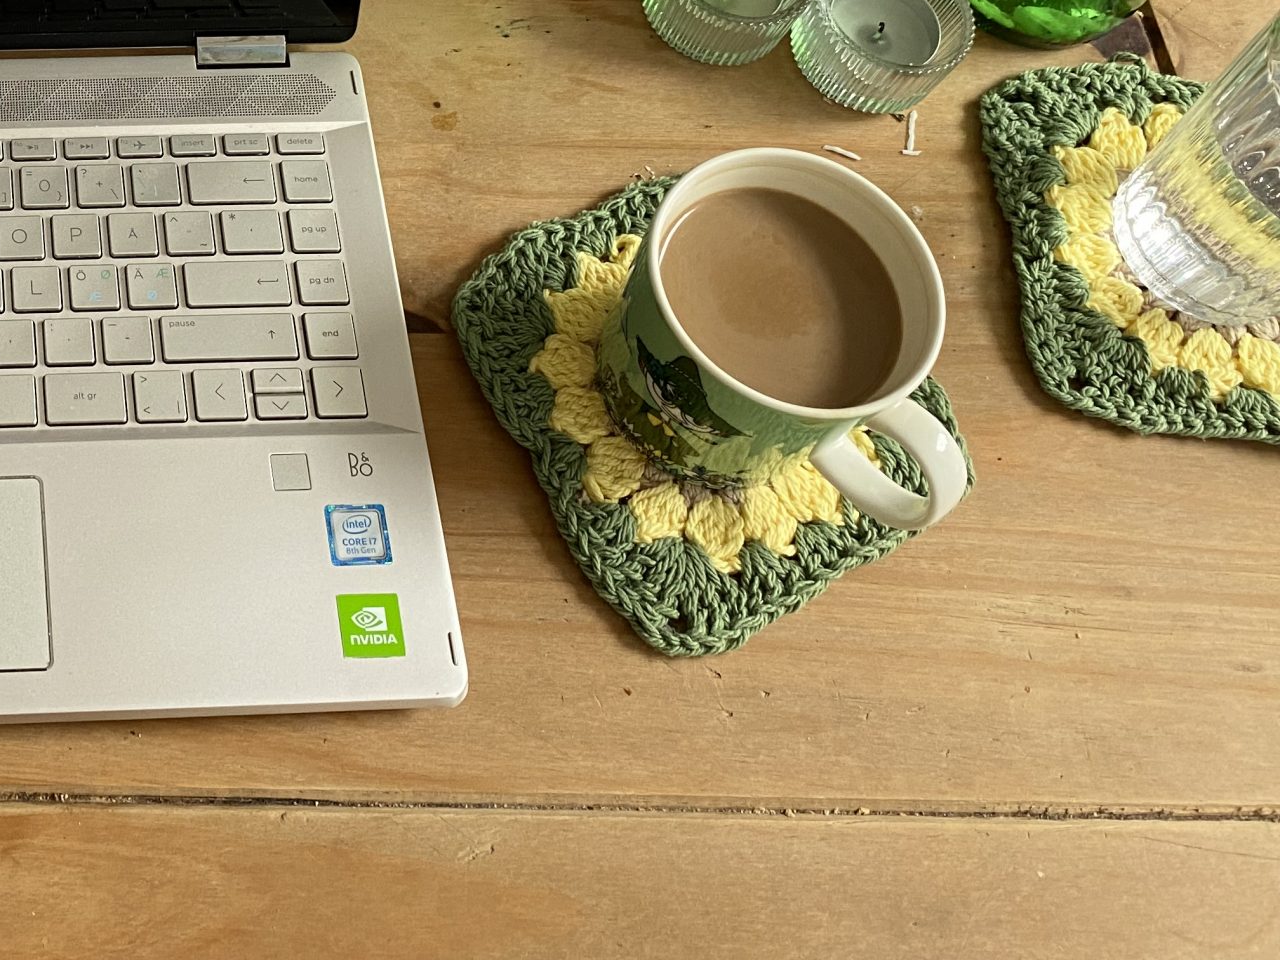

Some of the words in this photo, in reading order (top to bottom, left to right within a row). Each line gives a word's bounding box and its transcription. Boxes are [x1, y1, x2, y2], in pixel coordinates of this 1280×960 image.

[233, 138, 248, 146] prt
[301, 226, 313, 234] pg
[315, 226, 327, 234] up
[309, 277, 321, 285] pg
[323, 276, 335, 284] dn
[168, 320, 195, 328] pause
[73, 392, 85, 400] alt
[346, 518, 368, 529] intel
[342, 538, 368, 546] CORE
[346, 546, 360, 555] 8th
[361, 546, 376, 554] Gen
